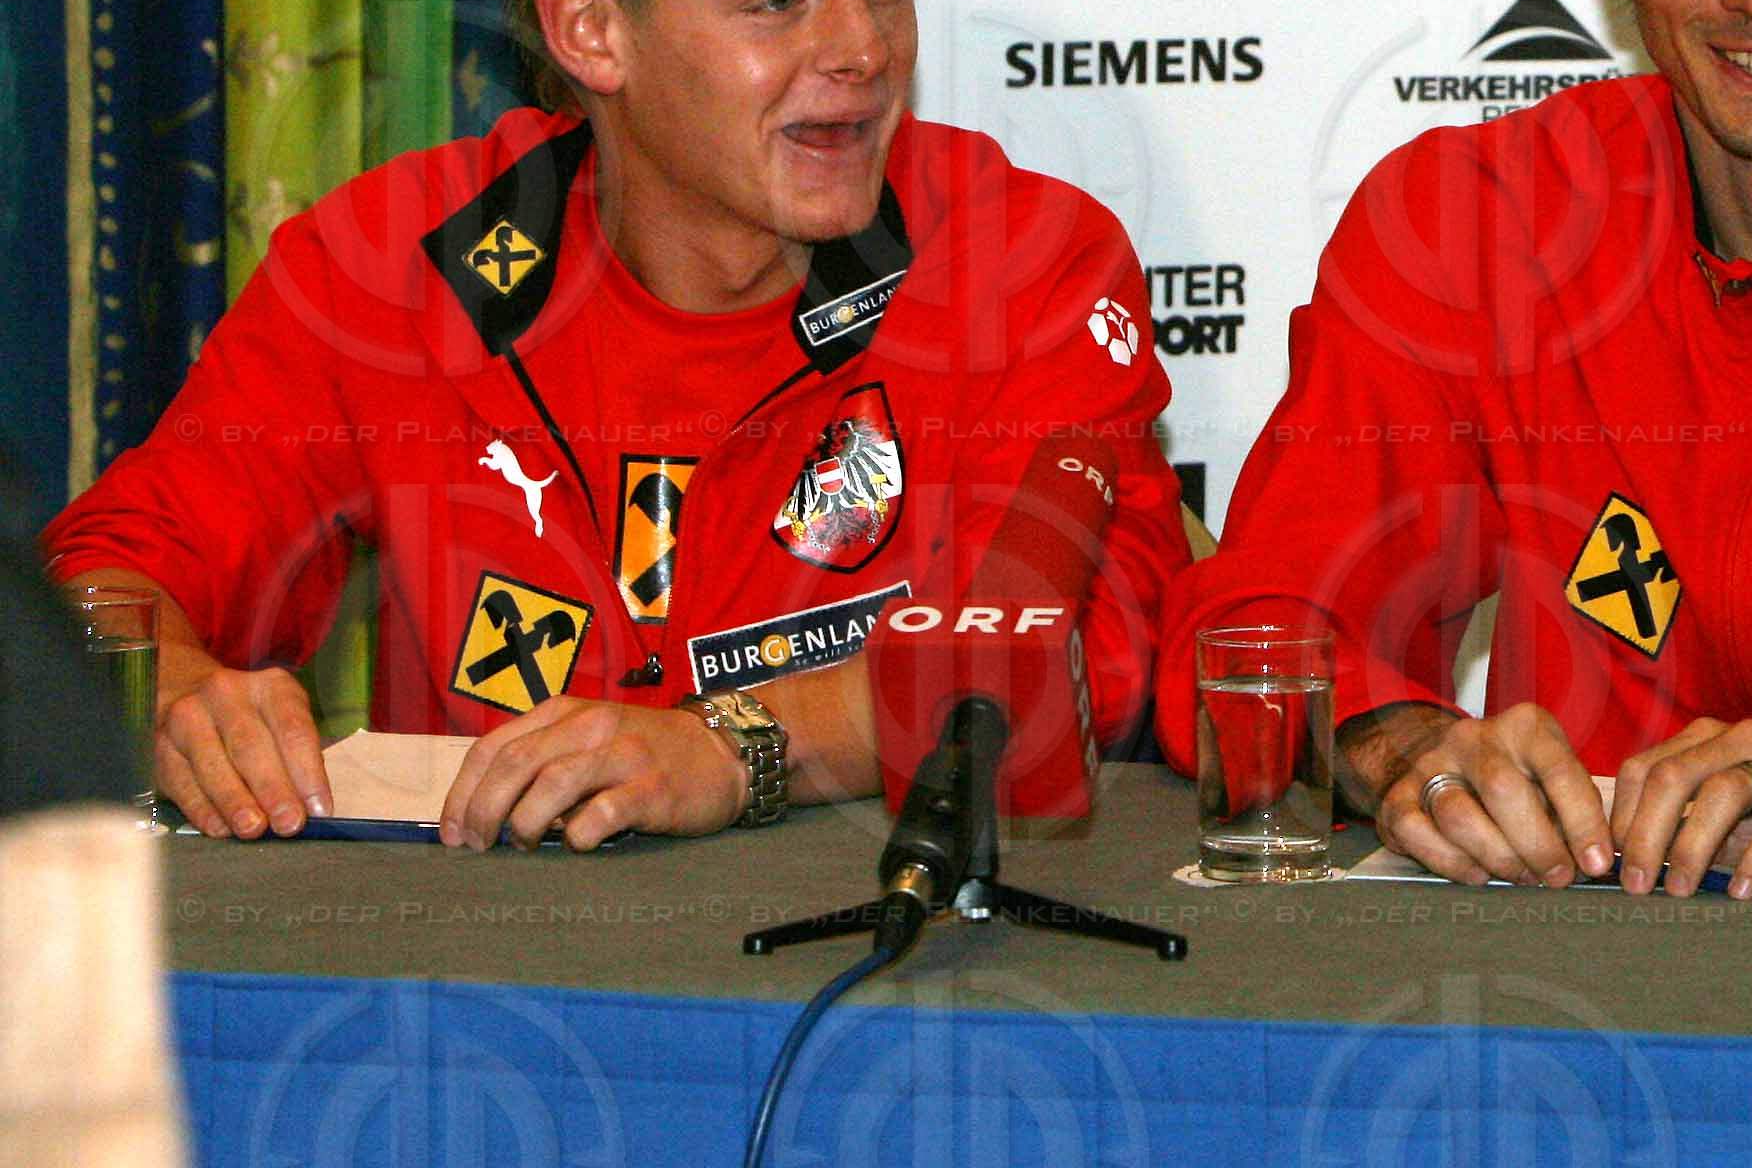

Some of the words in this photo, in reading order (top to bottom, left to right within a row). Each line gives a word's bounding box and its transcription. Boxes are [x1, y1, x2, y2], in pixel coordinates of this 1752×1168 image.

[1005, 36, 1264, 89] SIEMENS
[1146, 264, 1246, 310] TER
[1152, 314, 1245, 356] ORT
[888, 605, 1063, 634] ORF
[701, 608, 881, 679] BURGENLAN
